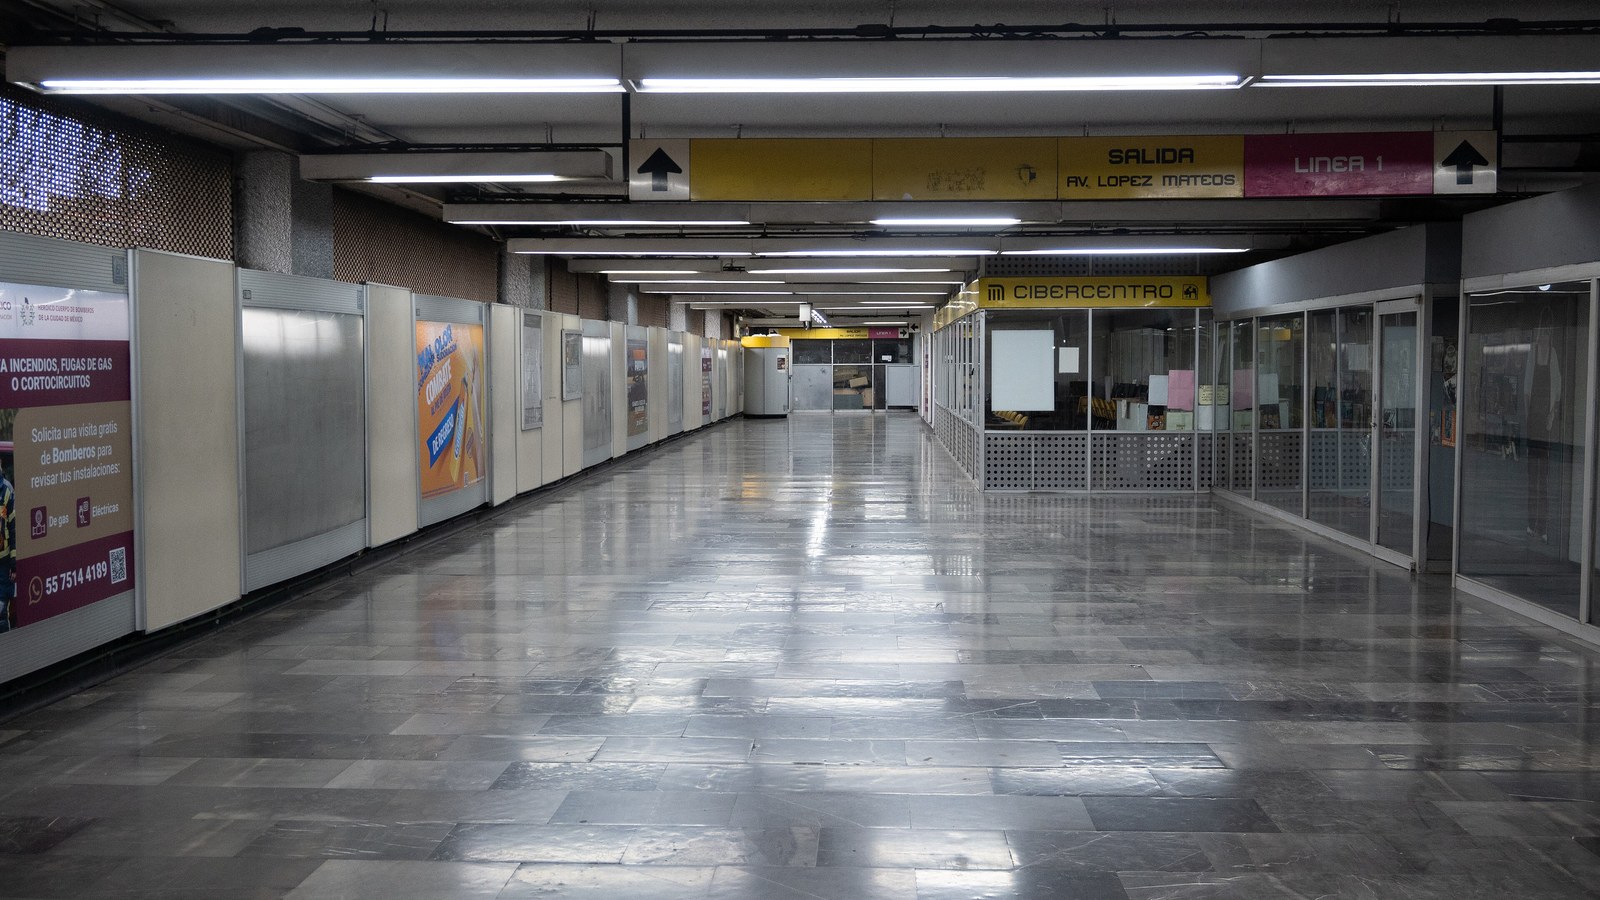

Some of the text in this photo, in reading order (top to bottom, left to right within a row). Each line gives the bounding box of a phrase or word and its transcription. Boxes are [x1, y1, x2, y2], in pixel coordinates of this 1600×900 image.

[1108, 148, 1194, 164] SALIDA
[1294, 155, 1383, 173] LINEA 1
[1066, 174, 1236, 187] AV. LOPEZ MATEOS
[1013, 285, 1172, 299] CIBERCENTRO
[10, 358, 60, 374] INCENDIOS,
[61, 358, 86, 371] FUGAS
[87, 358, 96, 371] DE
[98, 357, 112, 370] GAS
[12, 375, 91, 391] O CORTOCIRCUITOS
[31, 421, 117, 443] Solicita una visita gratis
[41, 444, 112, 465] de Bomberos para
[31, 463, 120, 489] revisar tus instalaciones:
[92, 503, 119, 518] Eléctricas
[49, 514, 69, 528] De gas
[45, 560, 108, 595] 55 7514 4189
